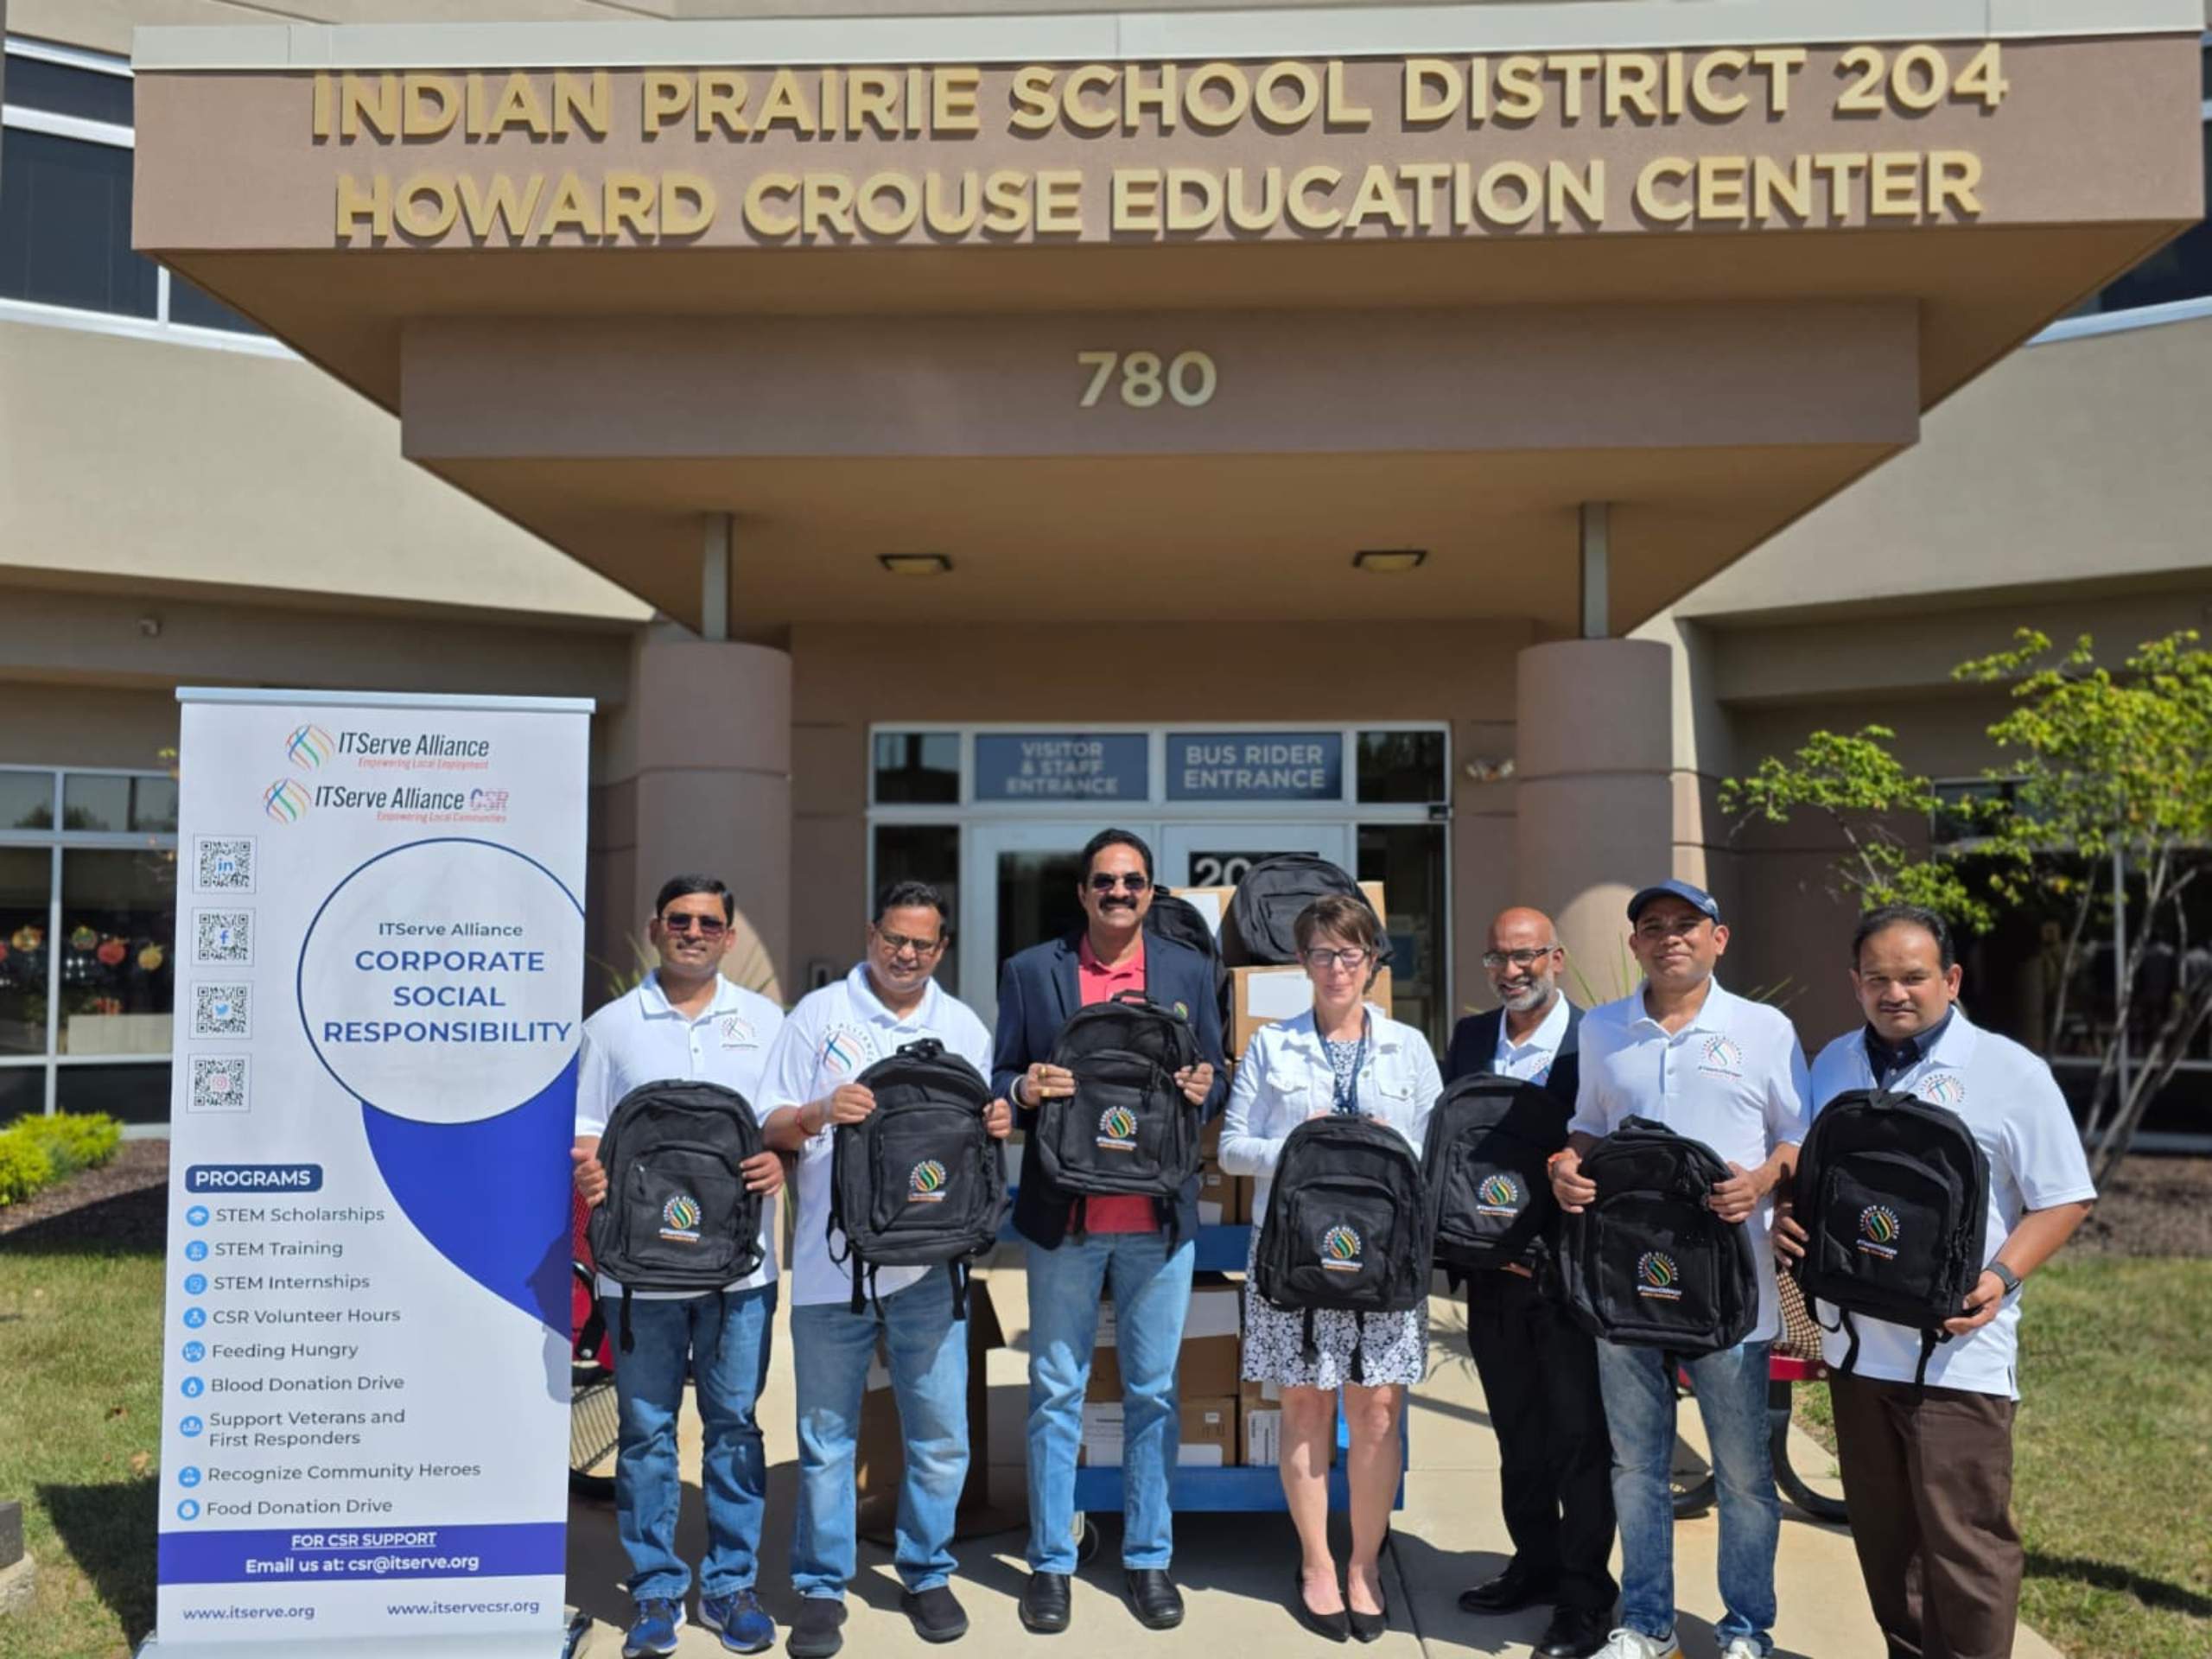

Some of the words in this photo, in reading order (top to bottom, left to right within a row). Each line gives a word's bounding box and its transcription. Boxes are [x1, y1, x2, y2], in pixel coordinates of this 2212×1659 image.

[313, 70, 607, 137] INDIAN
[644, 67, 980, 135] PRAIRIE
[1011, 60, 1371, 130] SCHOOL
[1405, 48, 1806, 121] DISTRICT
[1834, 41, 2009, 111] 204
[336, 171, 717, 238] HOWARD
[742, 168, 1083, 235] CROUSE
[1114, 159, 1605, 232] EDUCATION
[1637, 150, 1983, 221] CENTER
[1078, 351, 1217, 408] 780
[339, 732, 410, 755] ITServe
[416, 734, 490, 758] Alliance
[1021, 741, 1104, 758] VISITOR
[1186, 745, 1236, 765] BUS
[1245, 744, 1323, 765] RIDER
[359, 758, 410, 770] Empowering
[413, 759, 435, 769] Local
[1040, 760, 1104, 775] STAFF
[1006, 777, 1119, 795] ENTRANCE
[1183, 768, 1325, 789] ENTRANCE
[315, 785, 387, 809] ITServe
[391, 787, 465, 810] Alliance
[470, 787, 510, 811] CSR
[218, 858, 233, 871] in
[378, 922, 447, 936] ITServe
[450, 922, 523, 937] Alliance
[355, 950, 545, 971] CORPORATE
[393, 986, 506, 1007] SOCIAL
[323, 1021, 572, 1042] RESPONSIBILITY
[195, 1170, 311, 1187] PROGRAMS
[216, 1208, 264, 1222] STEM
[270, 1206, 385, 1224] Scholarships
[215, 1243, 264, 1255] STEM
[269, 1241, 344, 1258] Training
[213, 1276, 263, 1290] STEM
[269, 1274, 370, 1290] Internships
[213, 1310, 250, 1324] CSR
[254, 1309, 343, 1324] Volunteer
[348, 1308, 401, 1323] Hours
[212, 1344, 286, 1360] Feeding
[291, 1343, 359, 1360] Hungry
[211, 1377, 264, 1392] Blood
[269, 1376, 353, 1392] Donation
[357, 1375, 404, 1390] Drive
[209, 1412, 283, 1428] Support
[288, 1411, 366, 1425] Veterans
[371, 1409, 405, 1423] and
[209, 1432, 248, 1447] First
[254, 1430, 361, 1449] Responders
[207, 1466, 302, 1483] Recognize
[307, 1464, 414, 1481] Community
[419, 1464, 481, 1478] Heroes
[207, 1501, 251, 1516] Food
[257, 1499, 340, 1515] Donation
[346, 1497, 393, 1513] Drive
[291, 1534, 326, 1548] FOR
[327, 1533, 360, 1548] CSR
[362, 1531, 437, 1547] SUPPORT
[245, 1557, 295, 1573] Email
[299, 1560, 320, 1573] us
[323, 1558, 345, 1572] at:
[348, 1556, 480, 1573] csr@itserve.org
[183, 1605, 315, 1620] www.itserve.org
[387, 1600, 540, 1617] www.itservecsr.org
